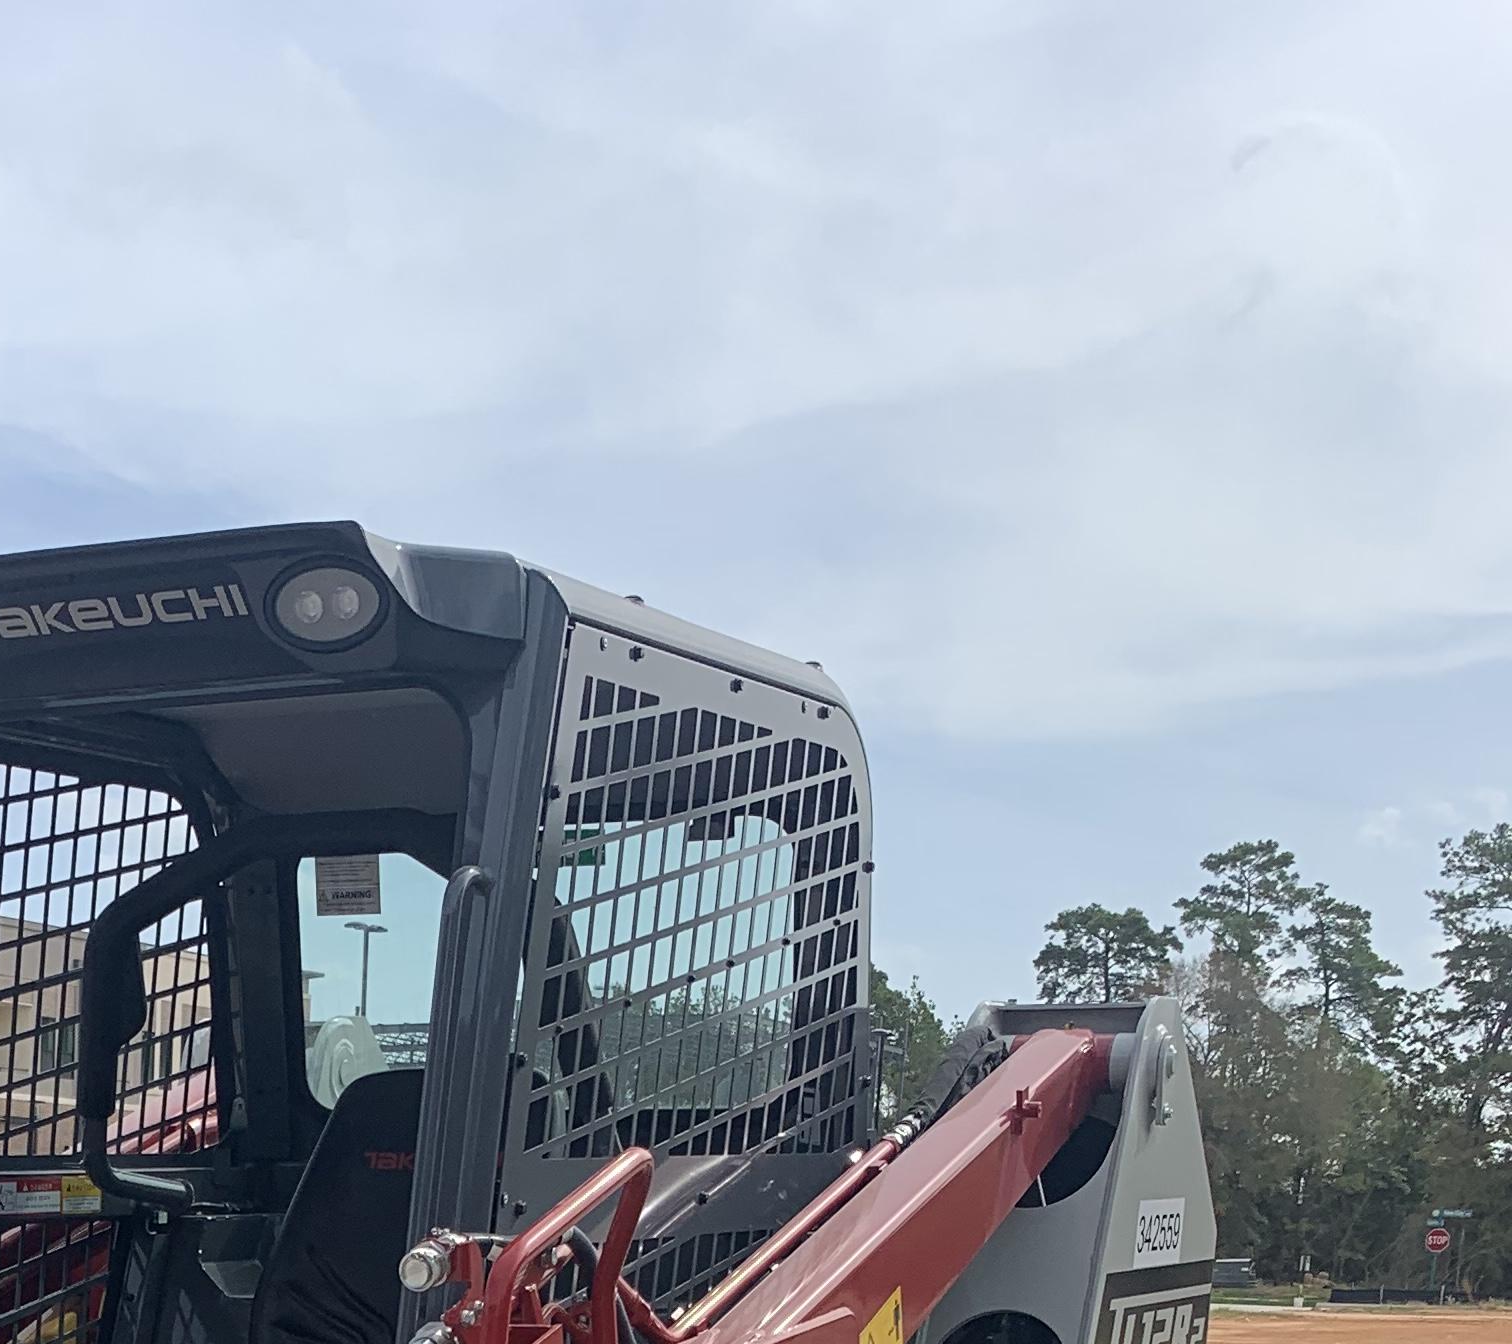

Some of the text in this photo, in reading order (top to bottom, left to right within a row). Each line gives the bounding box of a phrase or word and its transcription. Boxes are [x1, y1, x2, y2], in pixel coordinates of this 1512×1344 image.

[331, 889, 372, 900] WARNING
[1137, 1213, 1181, 1253] 342559
[1428, 1235, 1448, 1245] STOP
